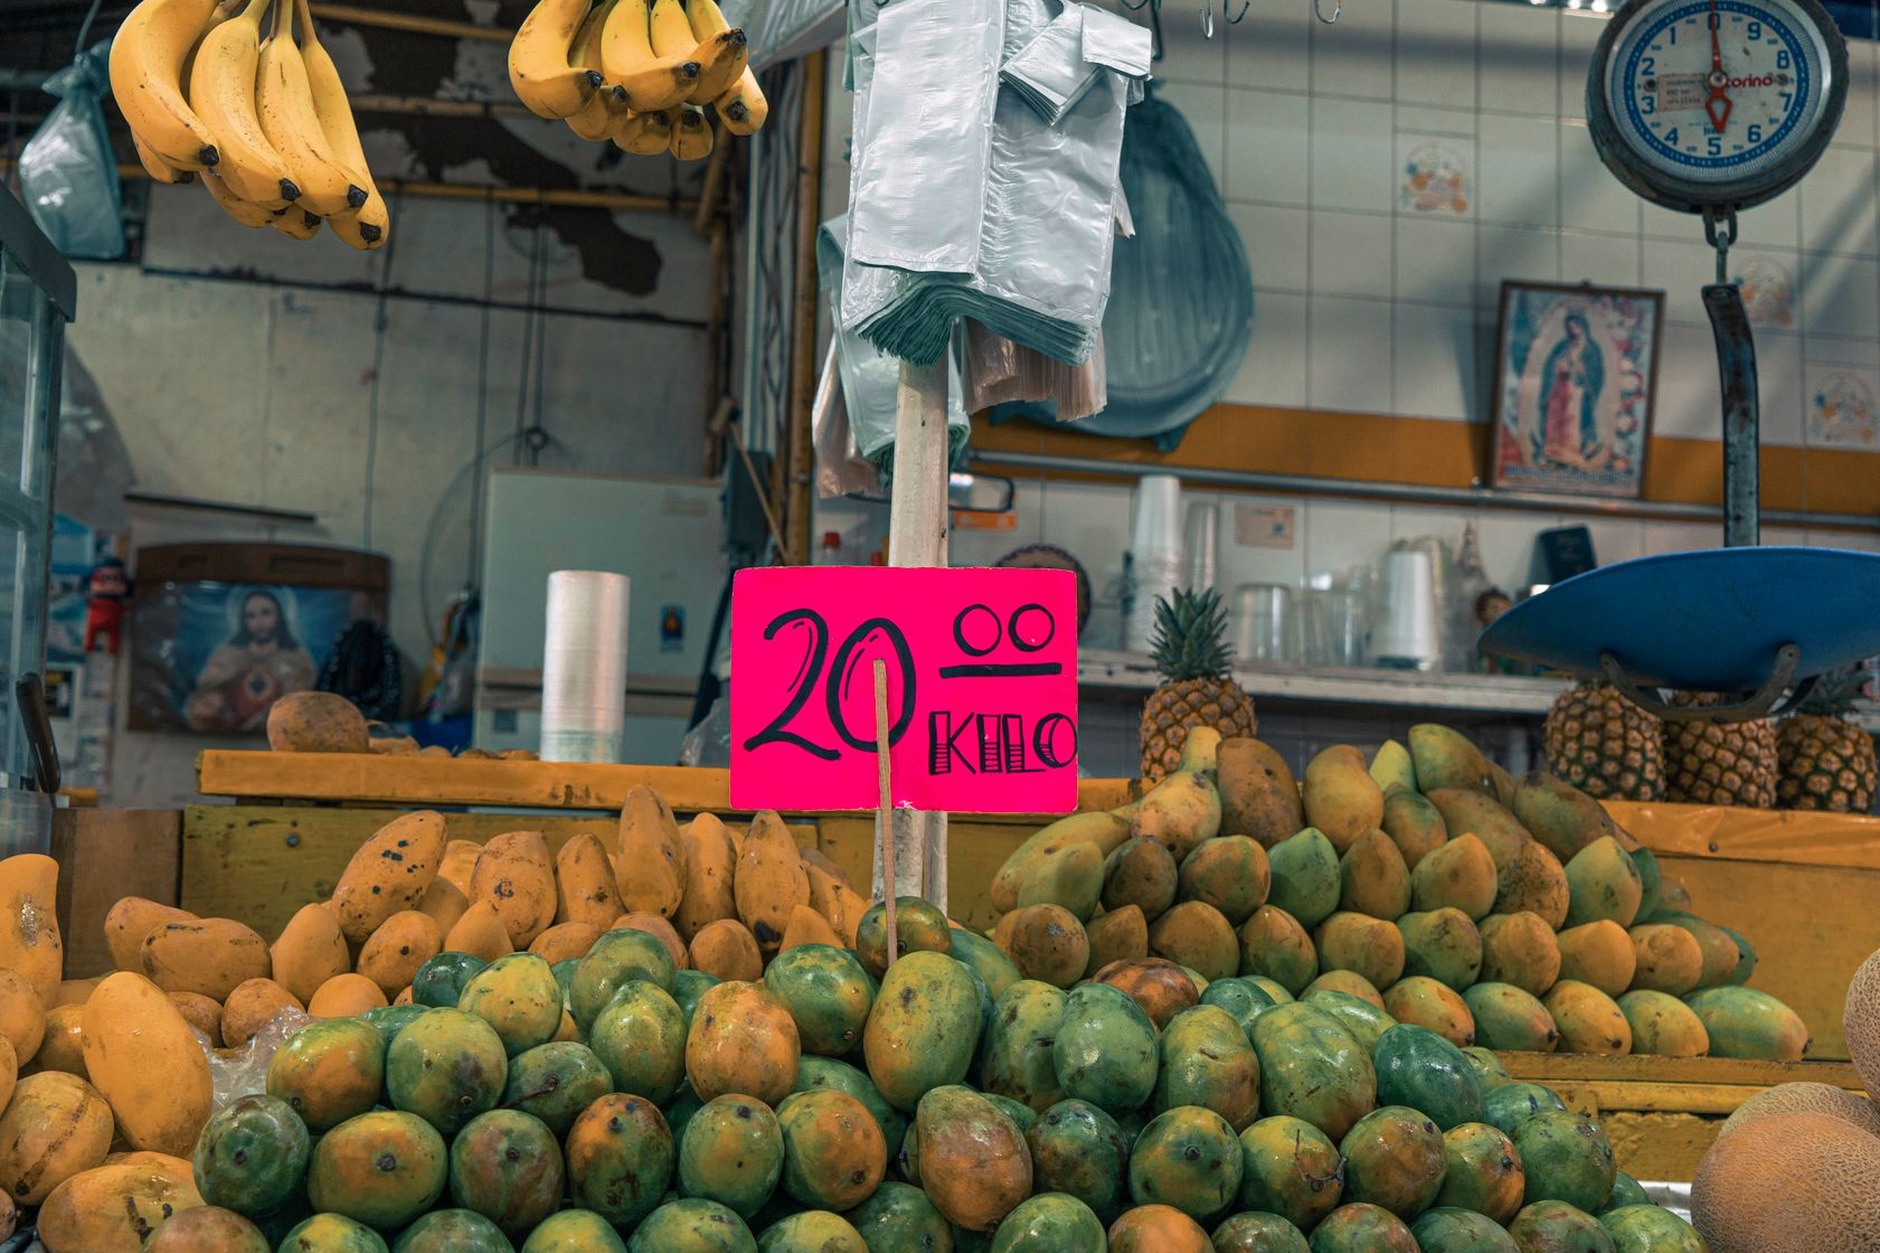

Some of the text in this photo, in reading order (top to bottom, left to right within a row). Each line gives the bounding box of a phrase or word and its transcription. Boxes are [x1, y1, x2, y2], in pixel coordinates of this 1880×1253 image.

[1669, 26, 1676, 45] 1
[1747, 22, 1761, 40] 9
[1641, 57, 1655, 76] 2
[1777, 50, 1790, 69] 8
[1641, 96, 1655, 114] 3
[1779, 93, 1792, 112] 7
[1664, 127, 1679, 146] 4
[1747, 124, 1761, 143] 6
[1707, 137, 1721, 155] 5
[744, 603, 1055, 761] 20 00
[928, 711, 1078, 776] KILO
